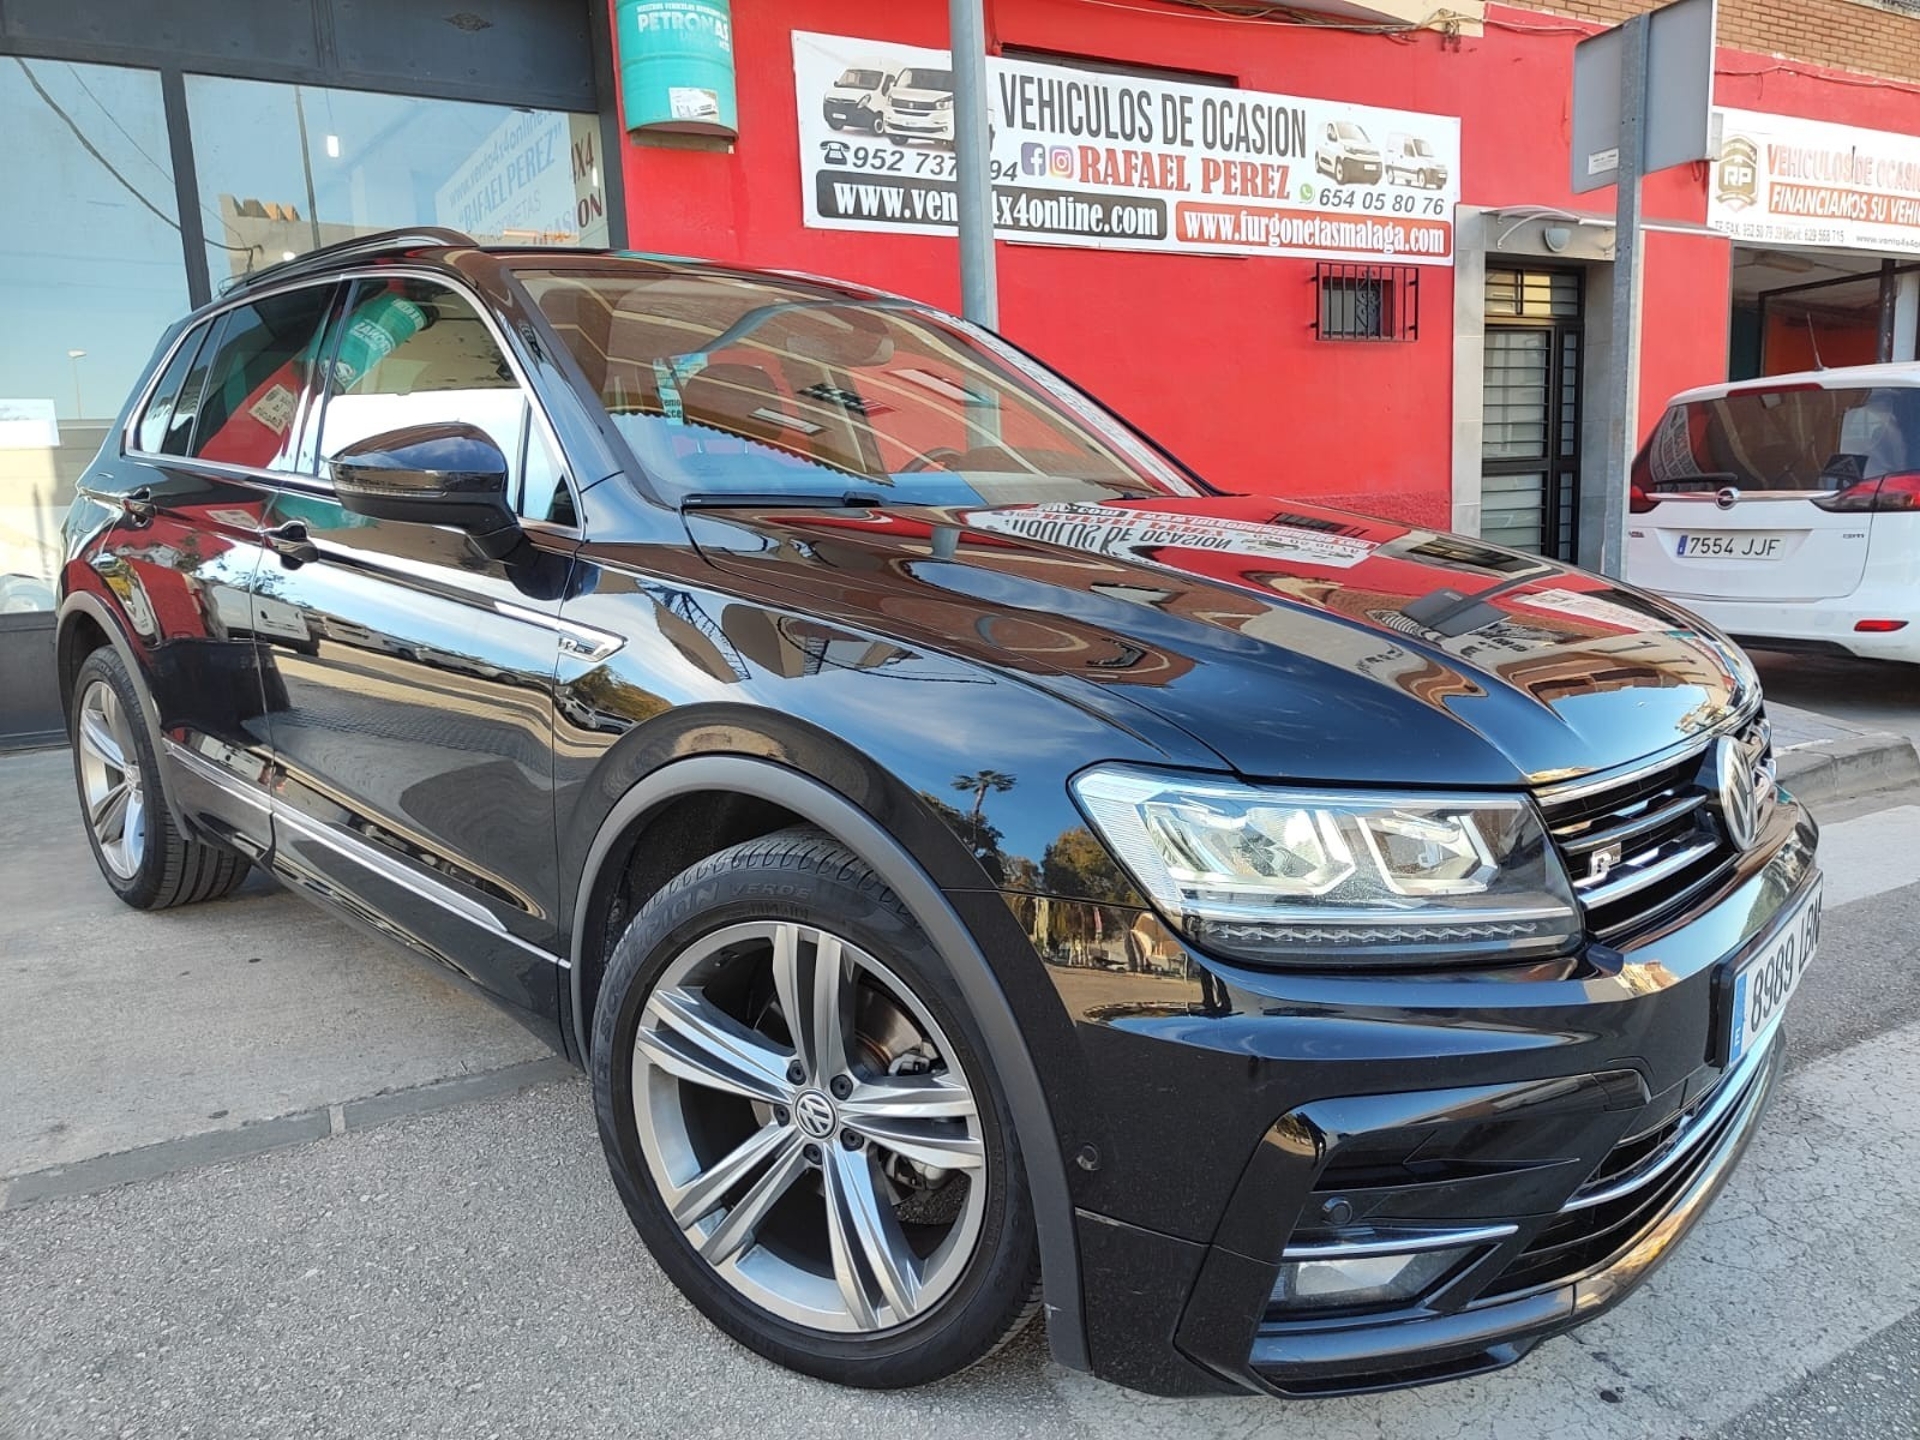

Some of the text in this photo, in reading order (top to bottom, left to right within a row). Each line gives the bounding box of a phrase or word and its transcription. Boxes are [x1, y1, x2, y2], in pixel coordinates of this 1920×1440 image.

[637, 11, 729, 41] PETRONAS
[999, 72, 1307, 158] VEHICULOS DE OCASION
[852, 147, 905, 171] 952
[915, 153, 958, 177] 737
[1078, 145, 1291, 200] RAFAEL PEREZ
[1767, 144, 1852, 182] VEHICULOS
[1877, 159, 1920, 193] OCASI
[1320, 188, 1445, 215] 654 05 80 76
[1771, 186, 1868, 219] FINANCIAMOS
[1870, 195, 1889, 222] SU
[1890, 197, 1920, 226] VEHI
[1183, 210, 1445, 254] www.furgonetasmalaga.com
[1690, 537, 1781, 556] 7554 JJF
[1751, 932, 1795, 1032] 8989
